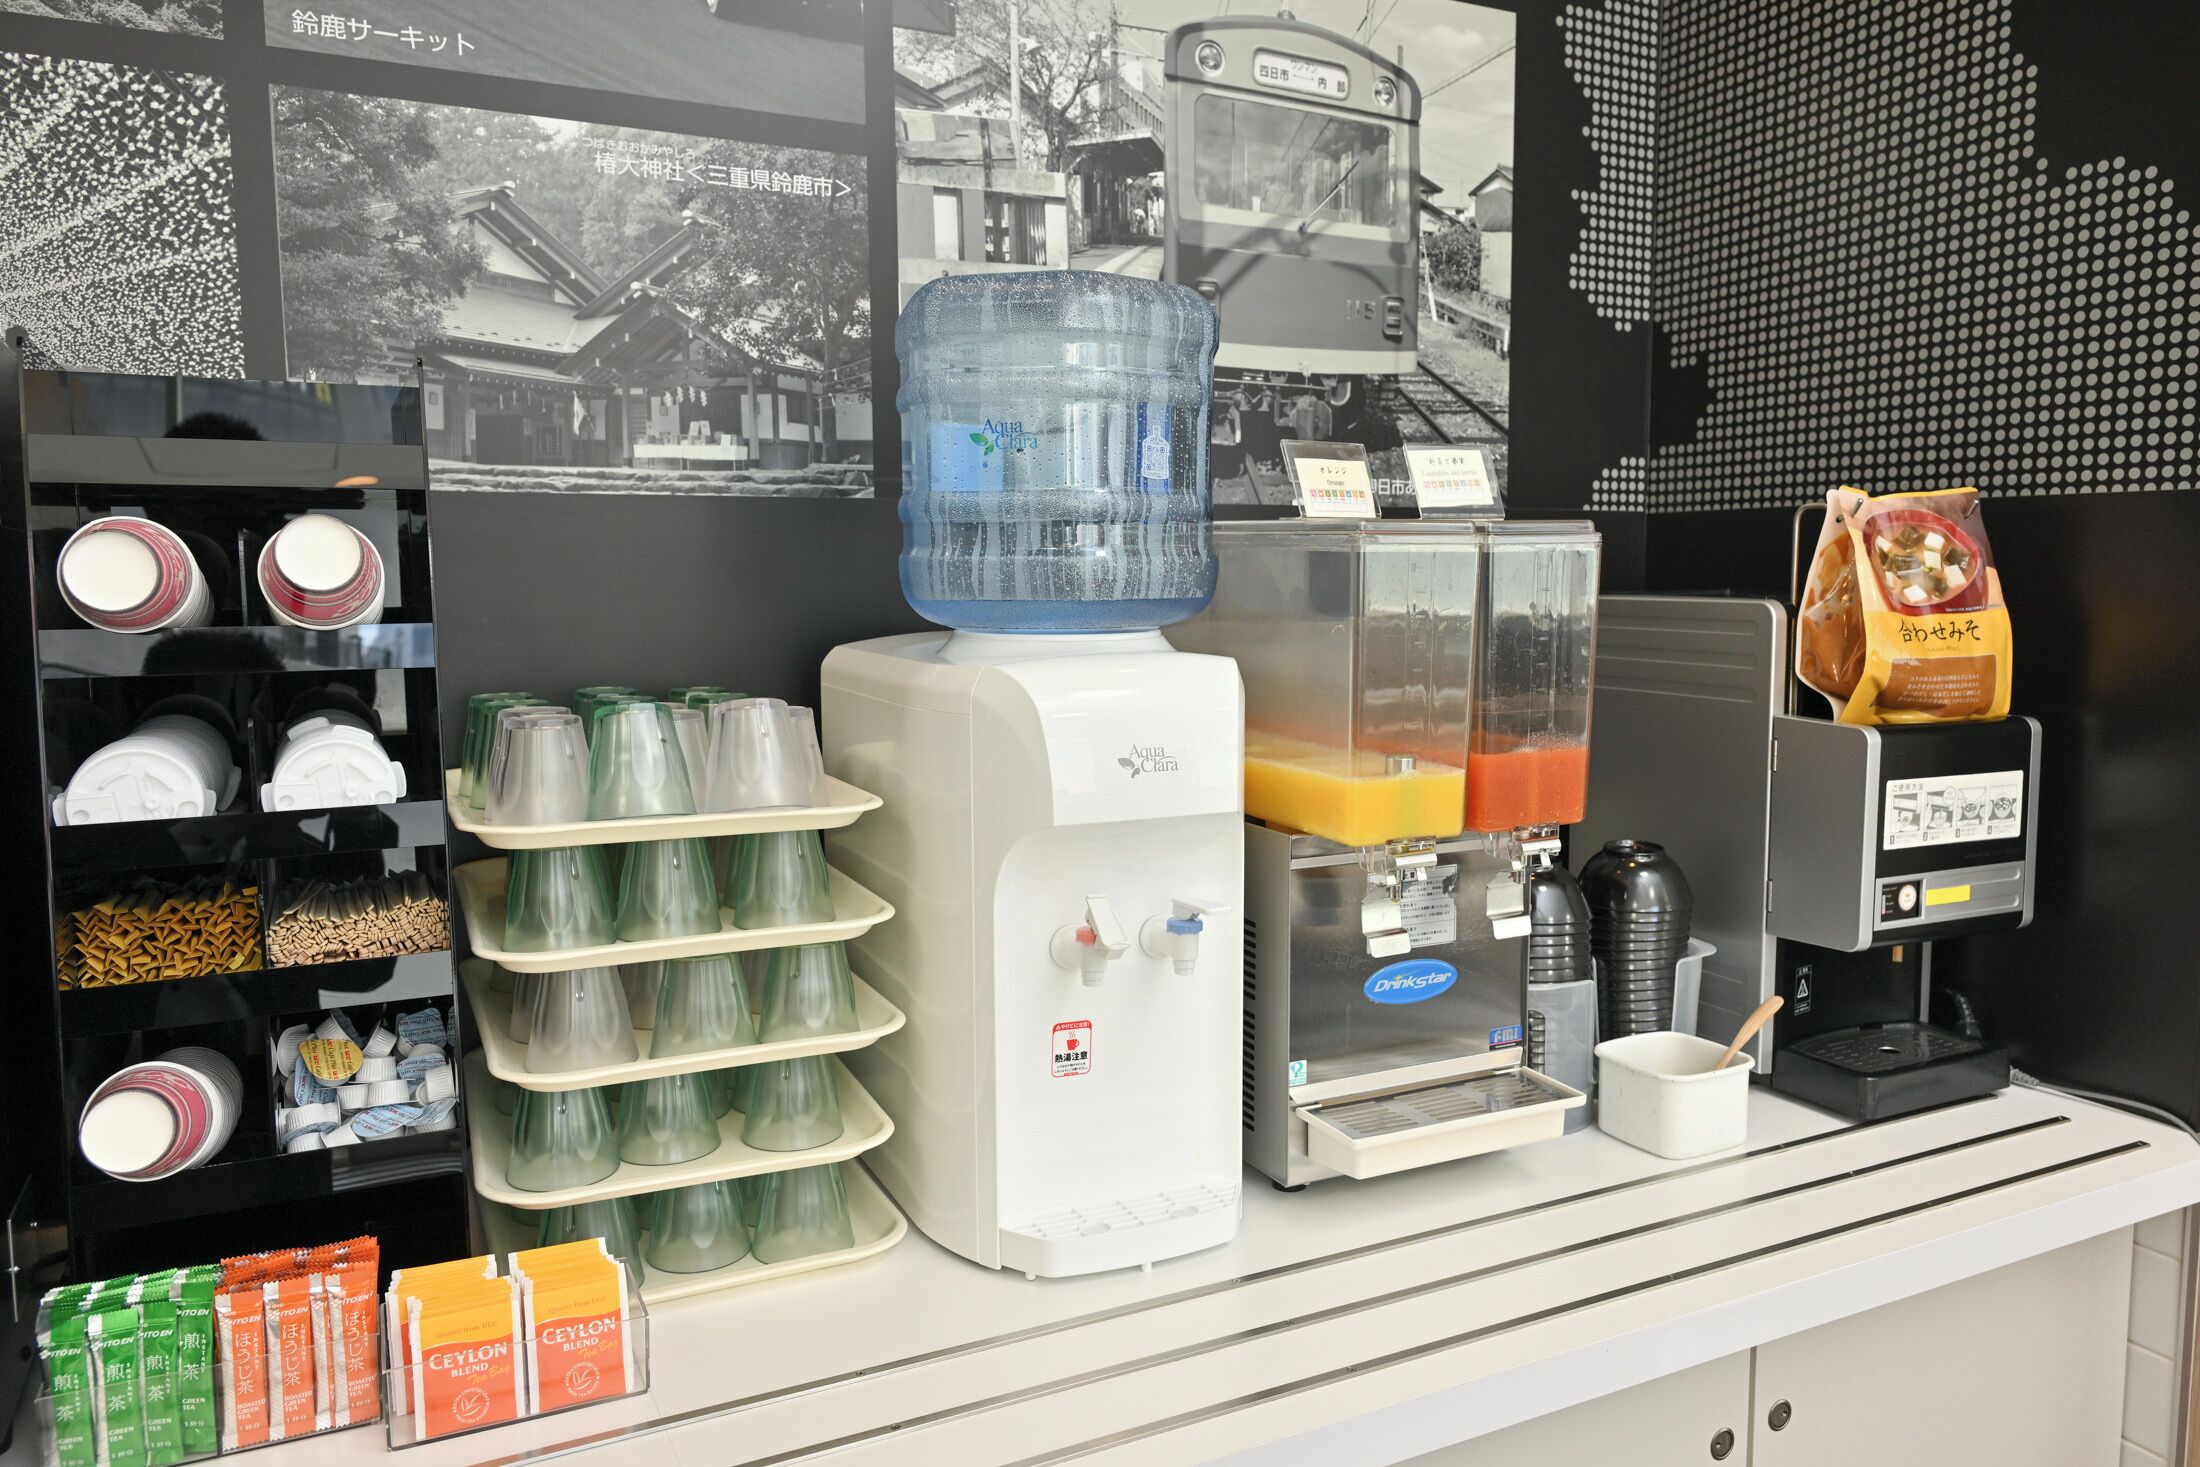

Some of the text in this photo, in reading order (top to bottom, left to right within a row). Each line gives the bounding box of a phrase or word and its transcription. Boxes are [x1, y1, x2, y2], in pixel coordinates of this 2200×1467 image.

[292, 9, 474, 55] 鈴鹿サーキット
[1260, 64, 1289, 81] 四日市
[582, 137, 695, 160] つばきおおかみやしろ
[982, 418, 1024, 435] Aqua
[995, 432, 1038, 450] Clara
[1899, 618, 1981, 642] 合わせみそ
[1129, 744, 1165, 760] Aqua
[1141, 758, 1178, 772] Clara
[1055, 1051, 1088, 1063] 熱湯注意
[542, 1316, 615, 1344] CEYLON
[345, 1311, 364, 1372] ほうじ茶
[563, 1337, 598, 1351] BLEND
[282, 1323, 301, 1386] ほうじ茶
[429, 1341, 507, 1370] CEYLON
[235, 1333, 254, 1395] ほうじ茶
[451, 1362, 489, 1377] BLEND
[349, 1373, 378, 1386] ROASTED
[349, 1383, 369, 1392] GREEN
[237, 1398, 266, 1409] ROASTED
[284, 1391, 313, 1401] ROASTED
[285, 1399, 306, 1407] GREEN
[237, 1406, 259, 1415] GREEN
[149, 1418, 172, 1426] GREEN
[109, 1426, 134, 1435] GREEN
[109, 1434, 123, 1442] TEA
